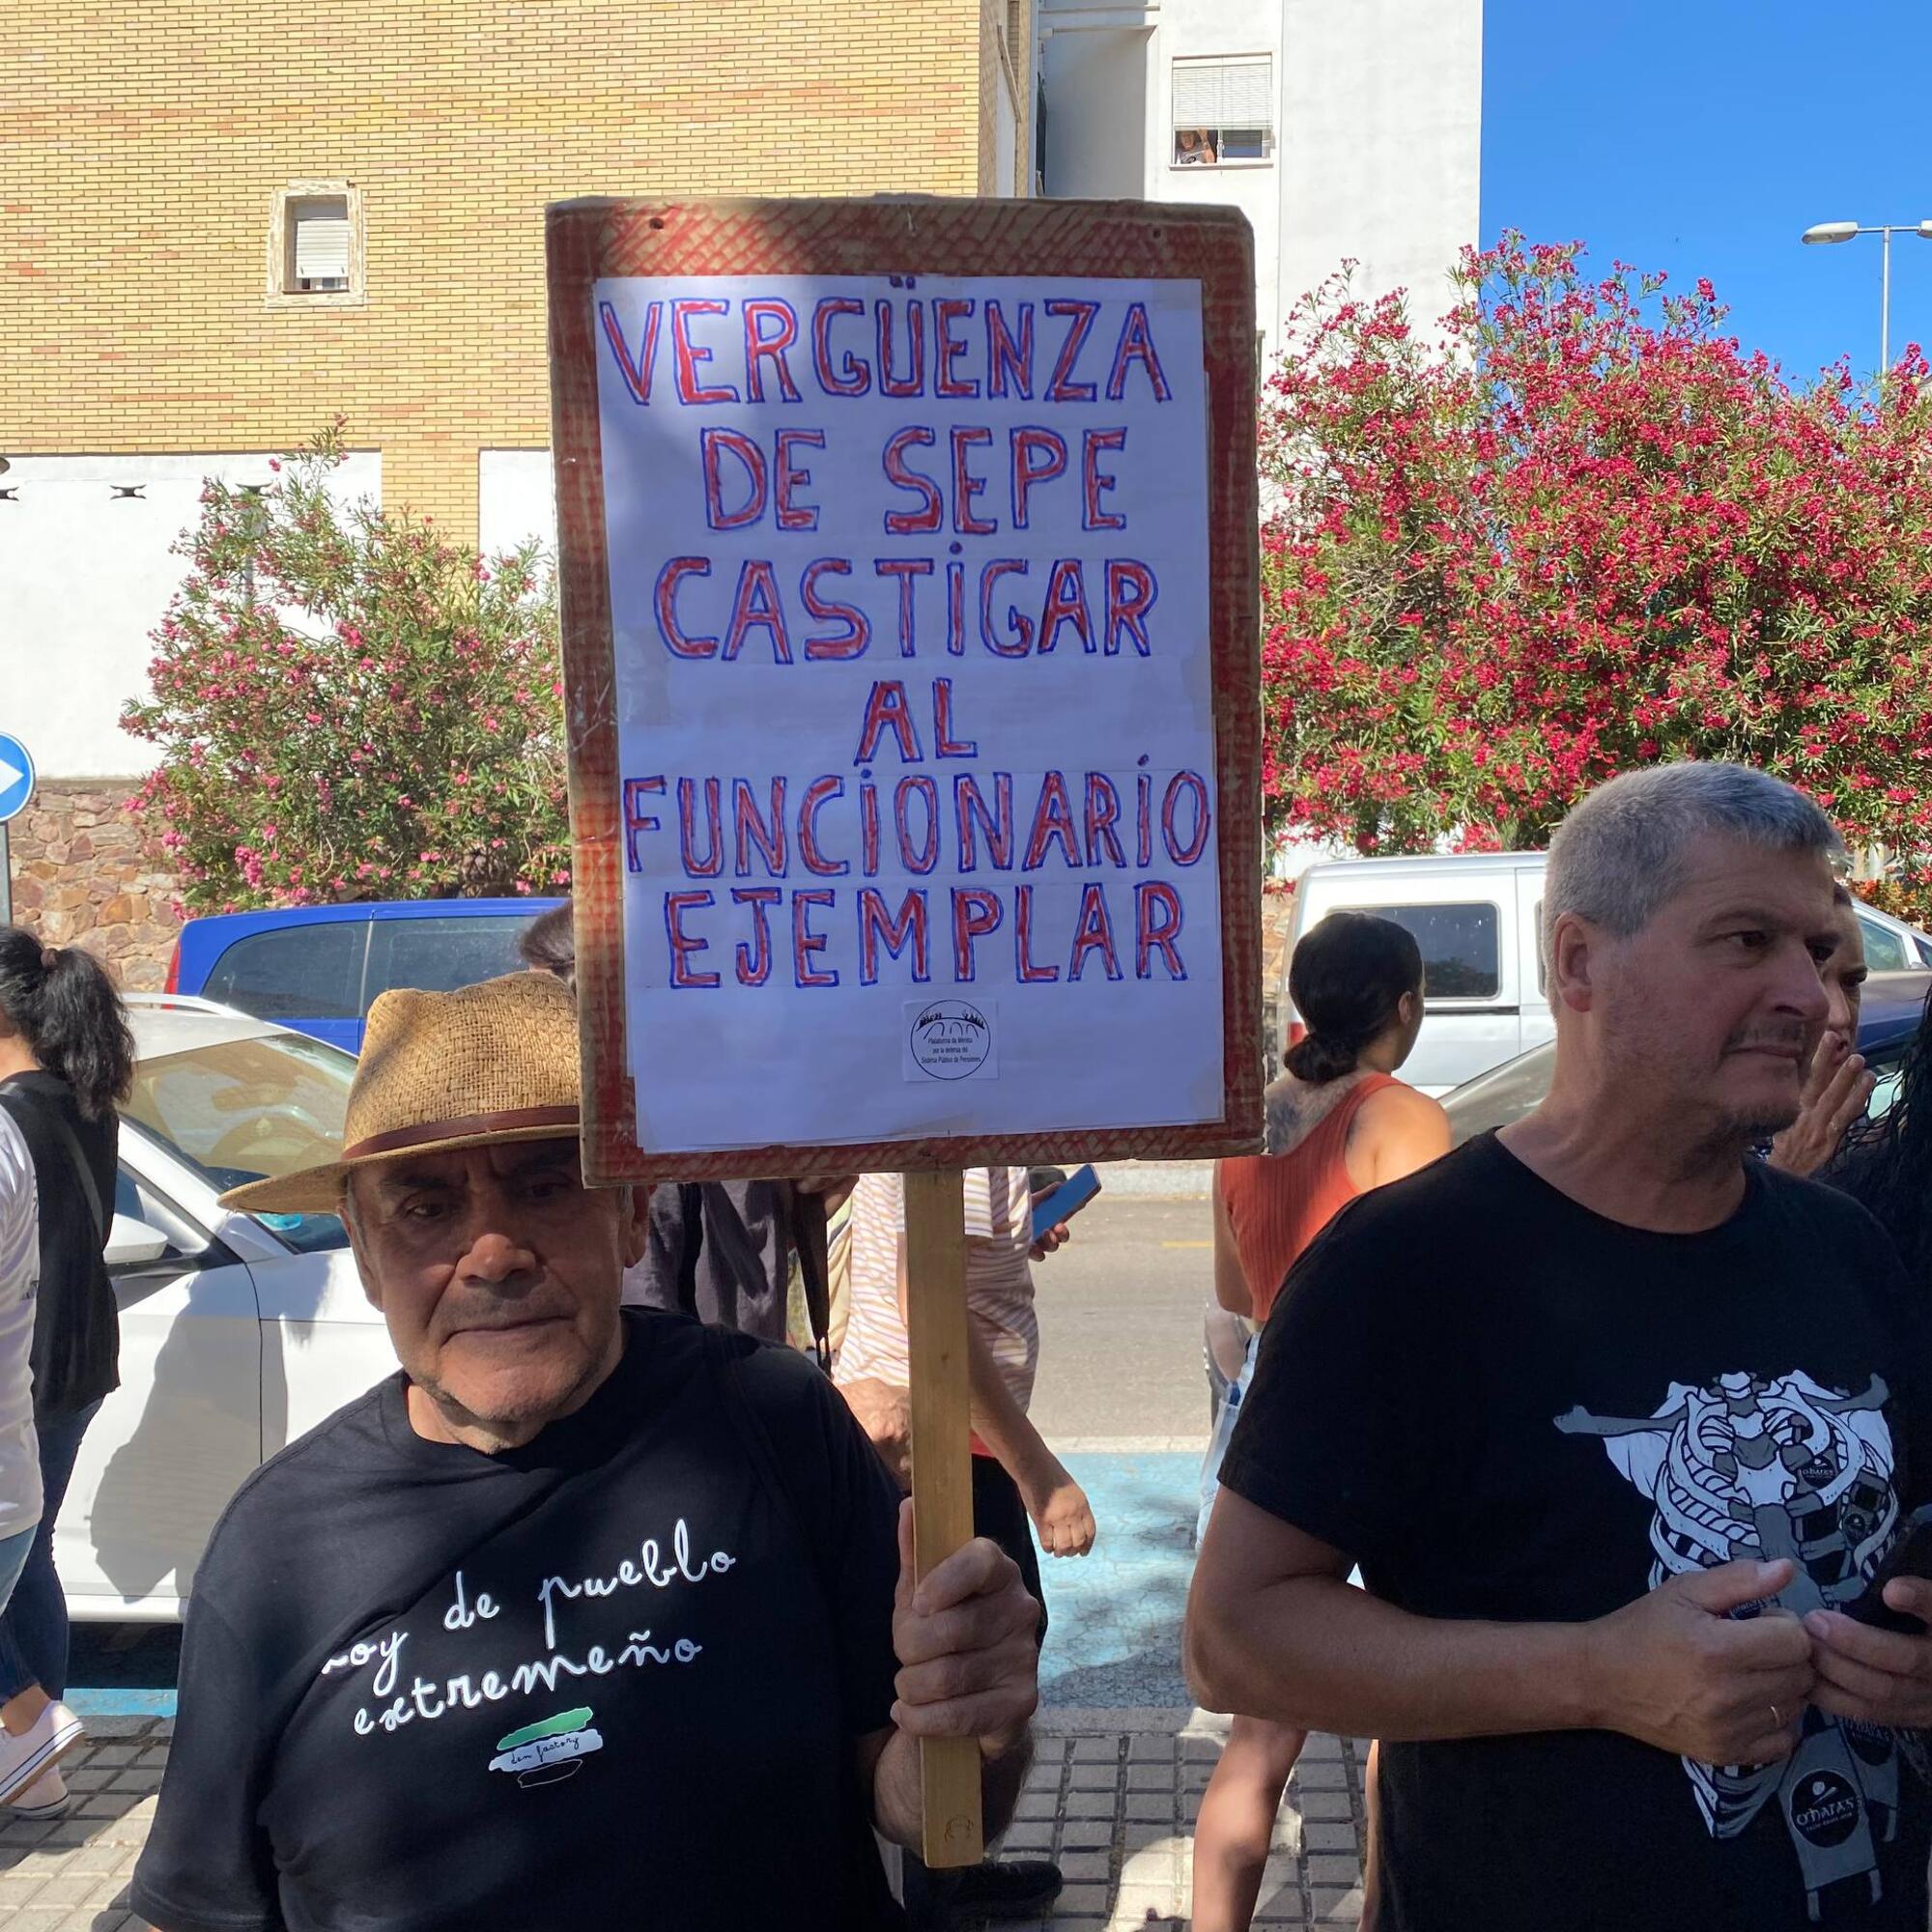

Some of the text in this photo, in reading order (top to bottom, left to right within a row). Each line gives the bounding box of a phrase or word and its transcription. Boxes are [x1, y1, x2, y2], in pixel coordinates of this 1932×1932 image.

[599, 275, 1172, 405] VERGÜENZA
[700, 425, 1127, 536] DE SEPE
[854, 677, 978, 766] AL
[664, 880, 1188, 989] EJEMPLAR
[443, 1519, 735, 1650] de pueblo
[354, 1630, 702, 1736] extremeño
